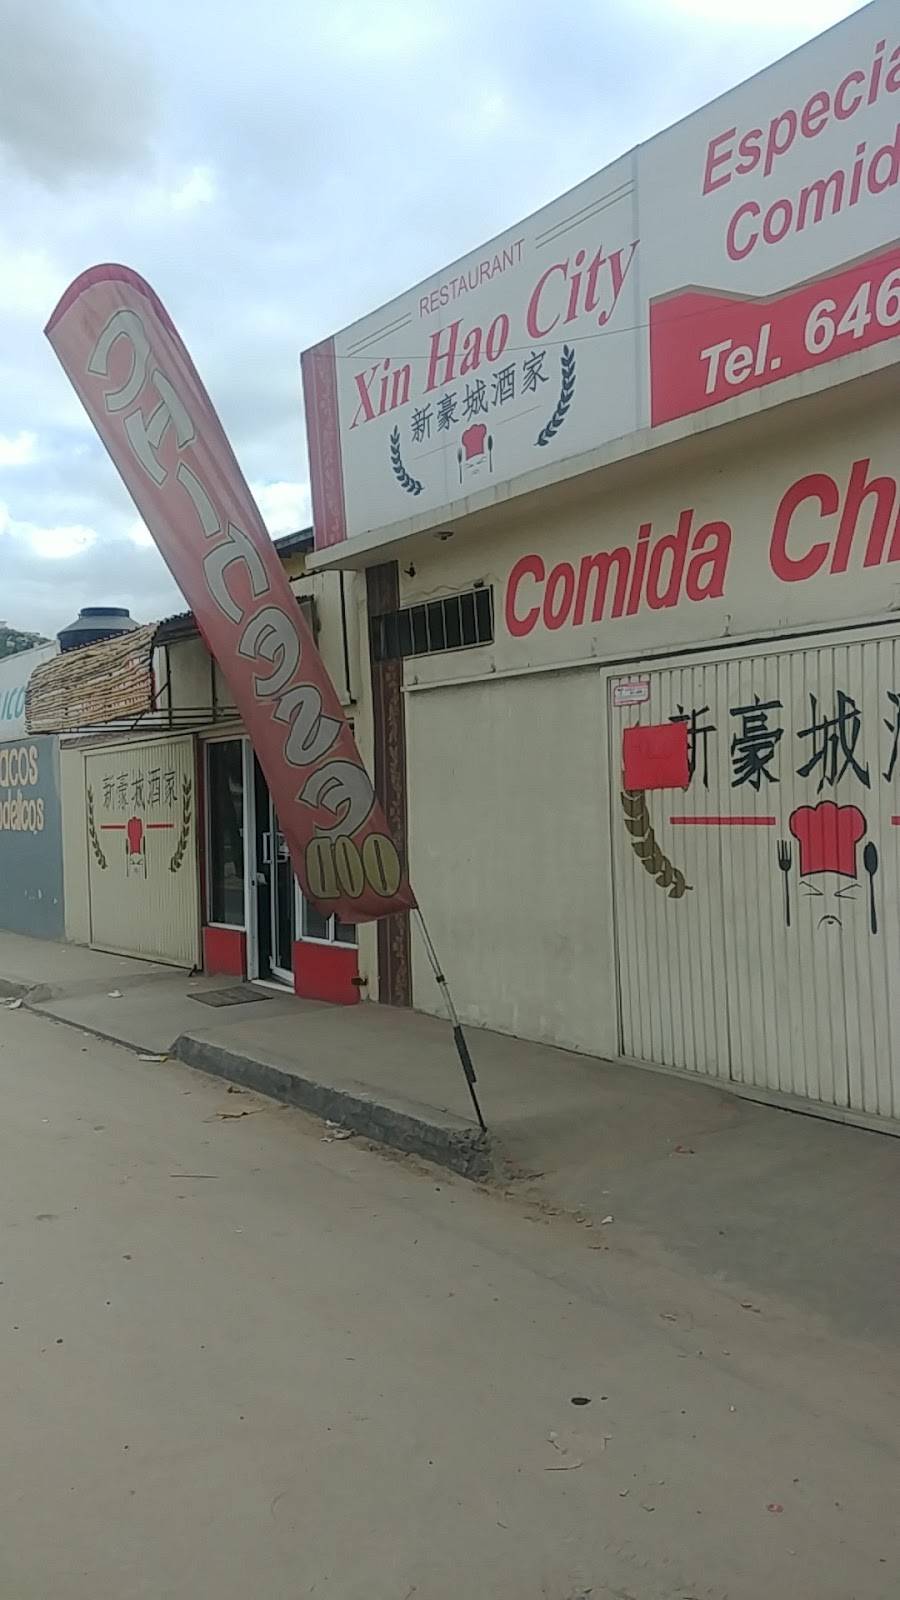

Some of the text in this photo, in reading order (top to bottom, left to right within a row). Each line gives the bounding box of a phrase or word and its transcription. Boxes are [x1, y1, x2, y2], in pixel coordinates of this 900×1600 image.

[702, 39, 900, 196] Especia
[725, 122, 900, 262] Comid
[349, 239, 641, 430] Xin Hao City
[419, 238, 525, 318] RESTAURANT
[699, 268, 900, 395] Tel. 646
[408, 350, 551, 443] 新豪城酒家
[505, 508, 732, 637] Comida
